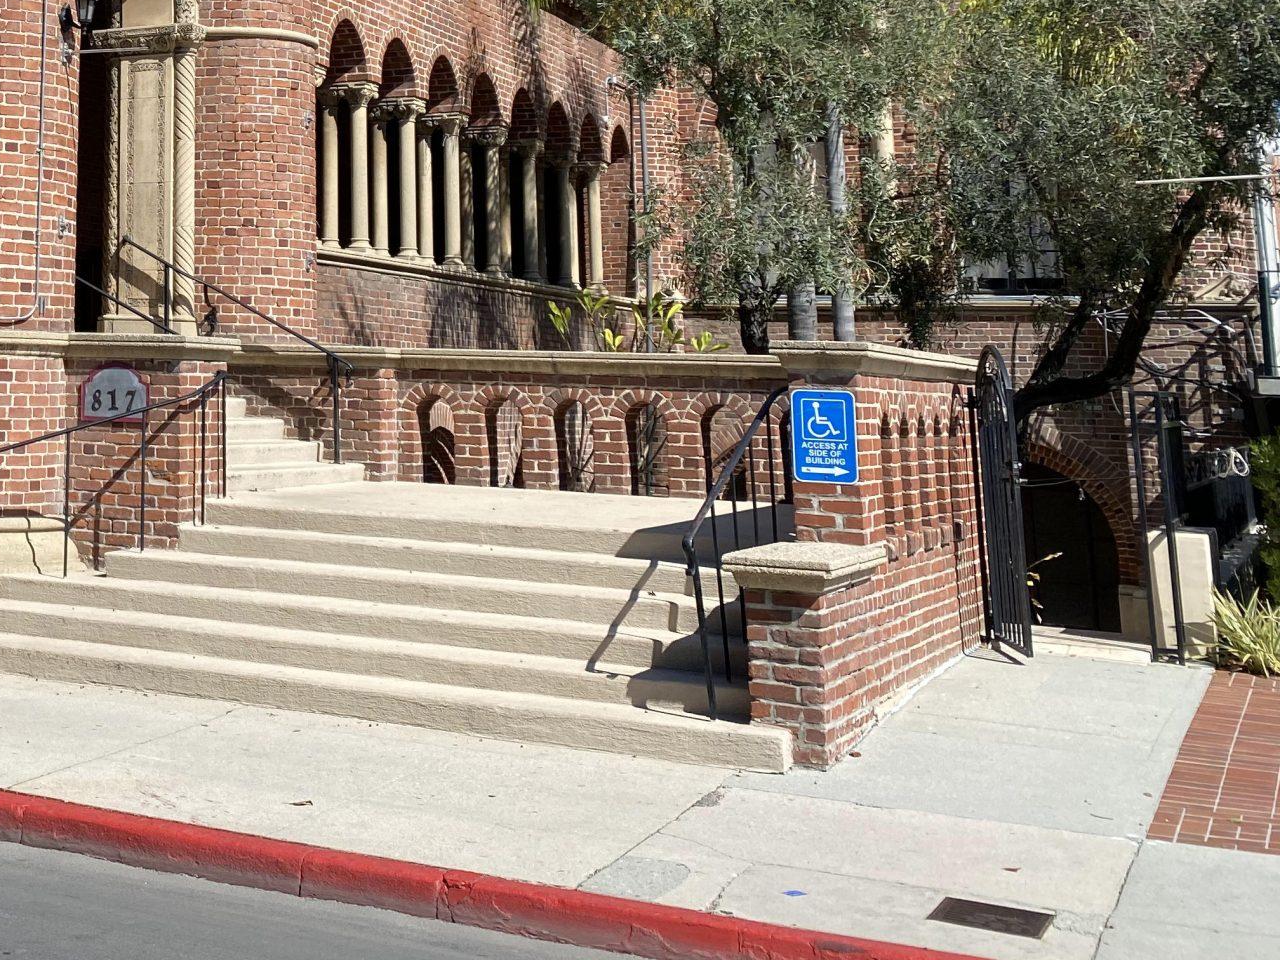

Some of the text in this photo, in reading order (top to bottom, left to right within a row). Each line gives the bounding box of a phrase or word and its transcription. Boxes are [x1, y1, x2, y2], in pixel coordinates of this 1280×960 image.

[91, 388, 137, 413] 817
[801, 442, 836, 450] ACCESS
[806, 456, 846, 466] BUILDING
